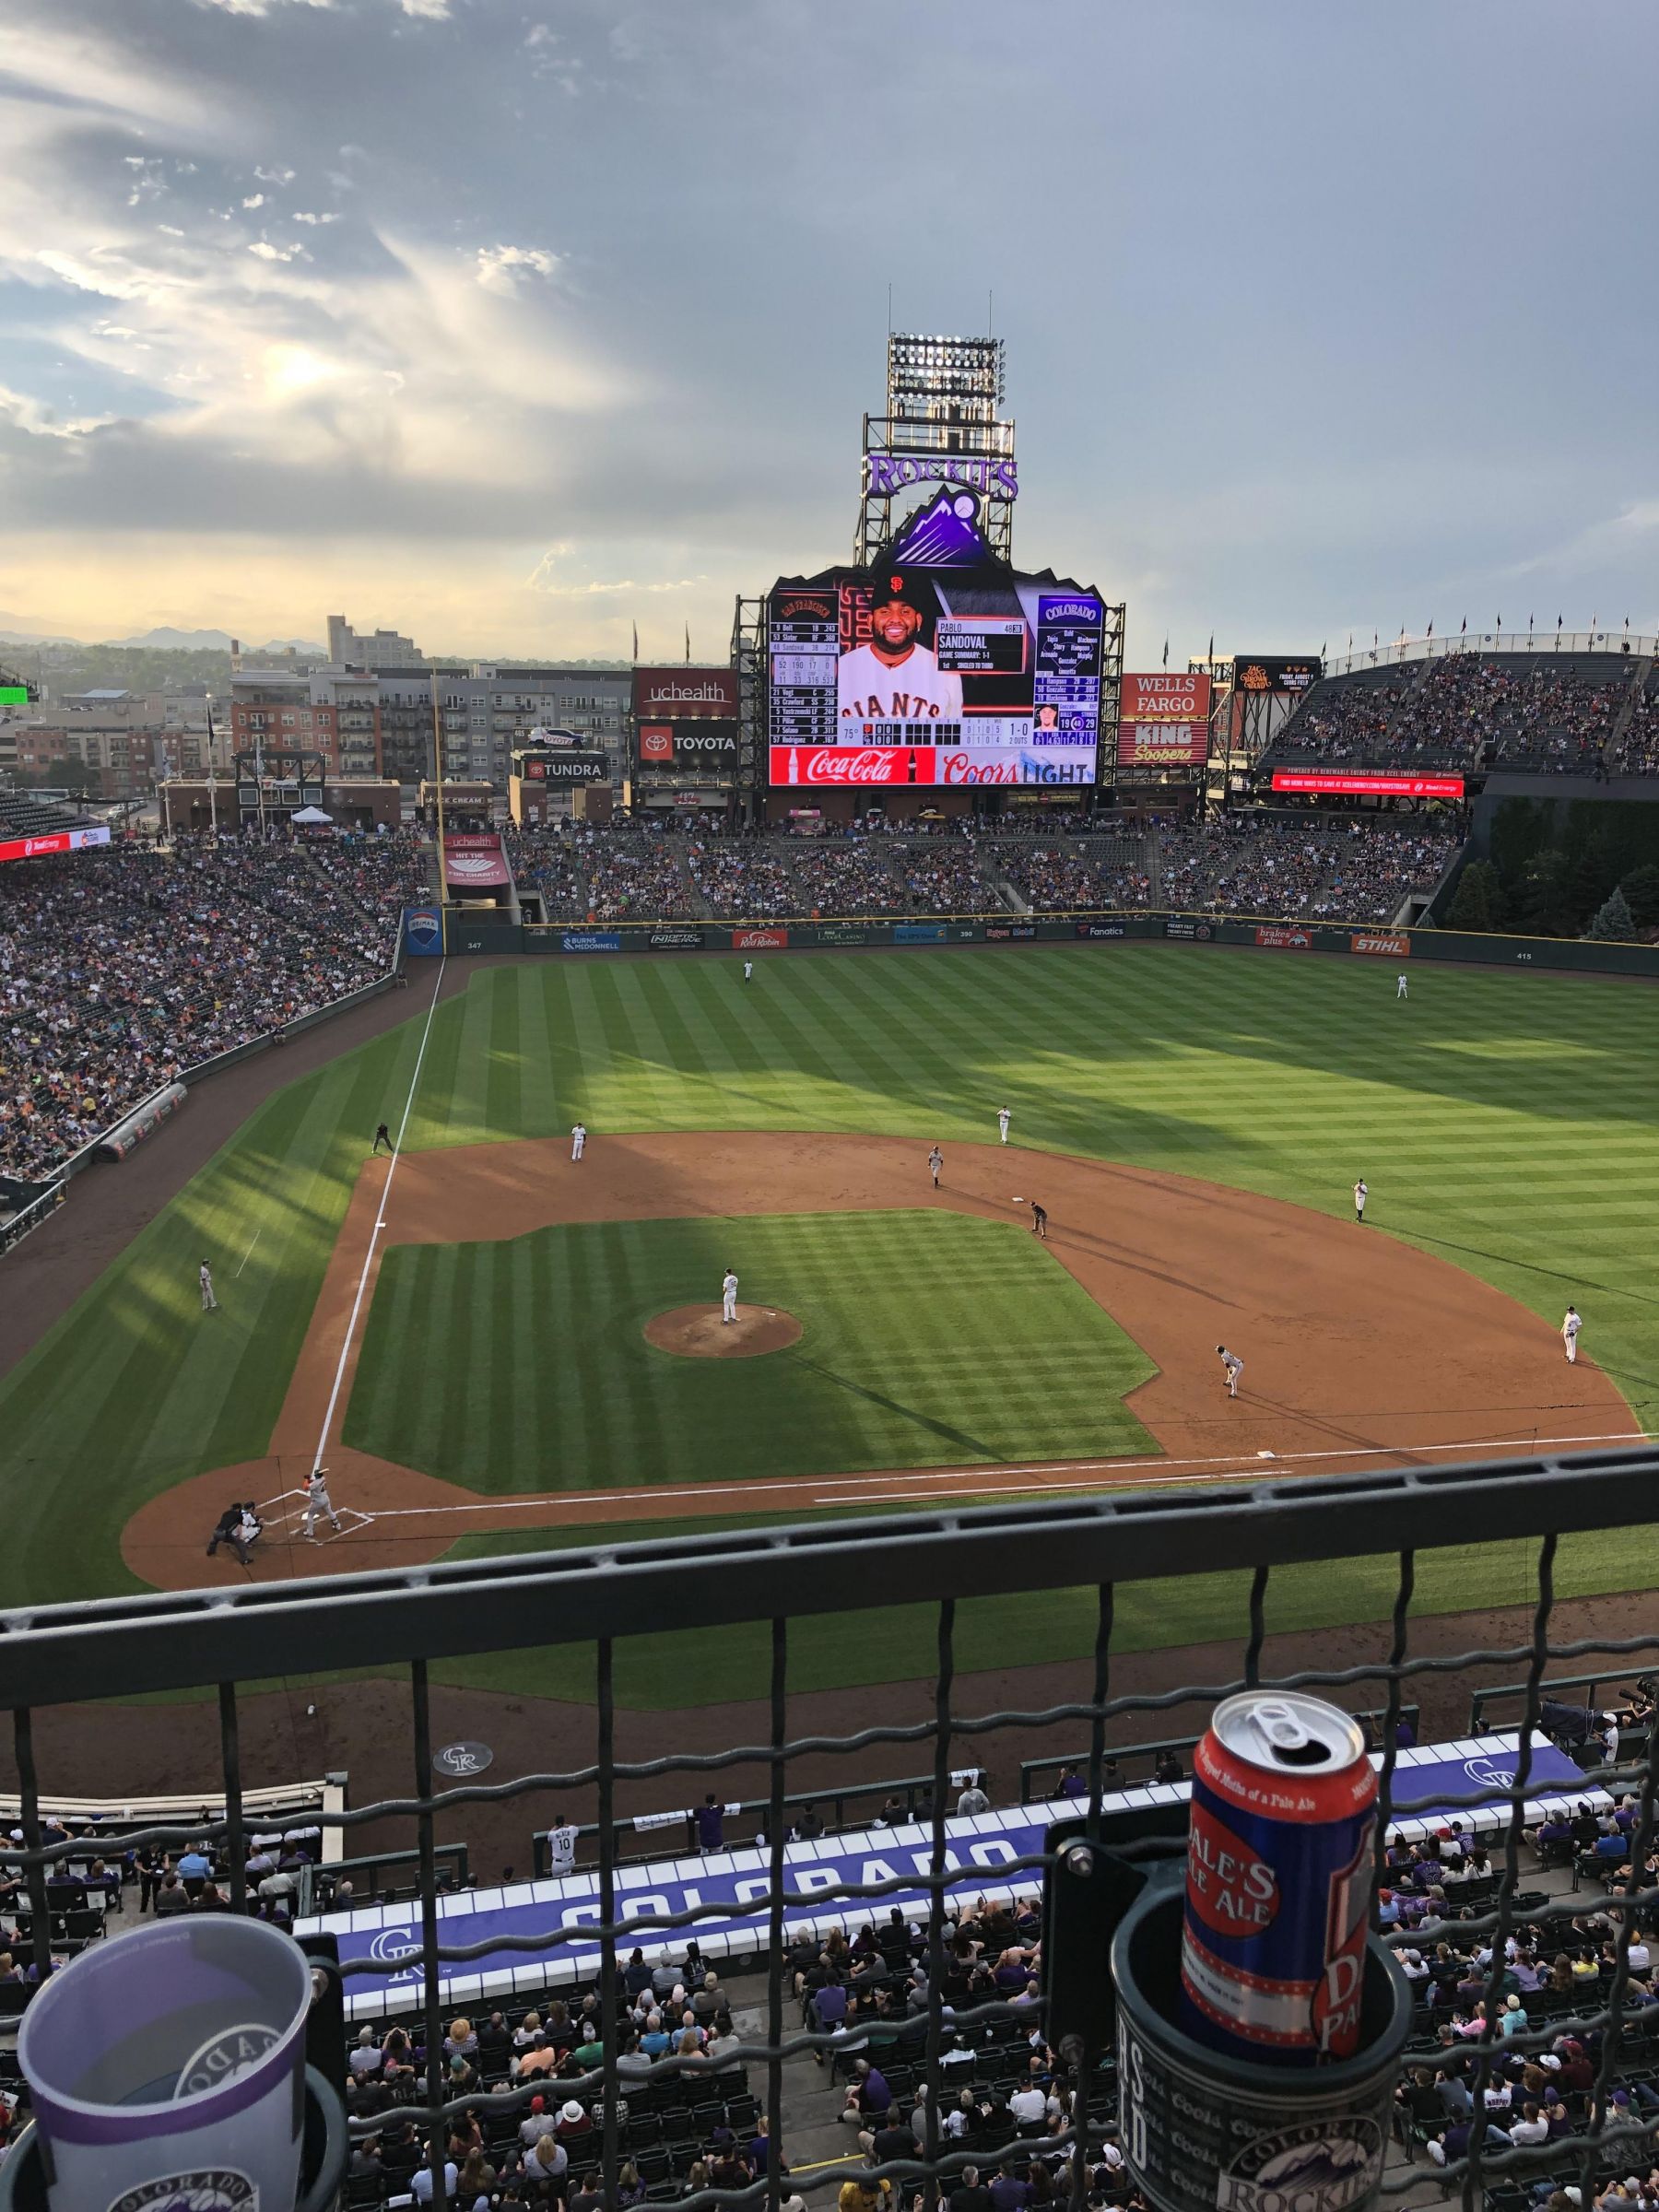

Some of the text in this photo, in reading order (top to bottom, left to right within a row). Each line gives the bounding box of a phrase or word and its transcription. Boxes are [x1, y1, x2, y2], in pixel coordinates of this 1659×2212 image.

[868, 454, 1018, 499] ROCKIES
[1045, 604, 1097, 621] COLORADO
[940, 623, 1013, 633] PABLO 48
[938, 635, 988, 649] SANDOVAL
[938, 651, 954, 659] GAME
[955, 651, 982, 659] SUMMARY:
[779, 661, 787, 669] 52
[650, 681, 725, 702] uchealth
[1136, 677, 1195, 692] WELLS
[1136, 697, 1195, 712] FARGO
[1061, 719, 1070, 729] 19
[1085, 719, 1095, 728] 29
[1135, 726, 1193, 745] KING
[673, 736, 736, 750] TOYOTA
[1133, 745, 1193, 761] Soopers
[545, 764, 602, 776] TUNDRA
[806, 750, 898, 782] Coca-Cola
[943, 752, 1088, 783] Coors LIGHT
[453, 836, 492, 847] uchealth
[1089, 926, 1124, 935] Fanatics
[1259, 929, 1290, 938] brakes
[739, 935, 780, 947] Red Robin
[1263, 937, 1283, 946] plus
[1356, 939, 1404, 953] STIHL
[1269, 1794, 1294, 1810] Pale
[1297, 1798, 1316, 1811] Ale
[559, 1838, 571, 1851] 10
[1189, 1825, 1276, 1900] ALE'S
[1215, 1889, 1271, 1926] ALE
